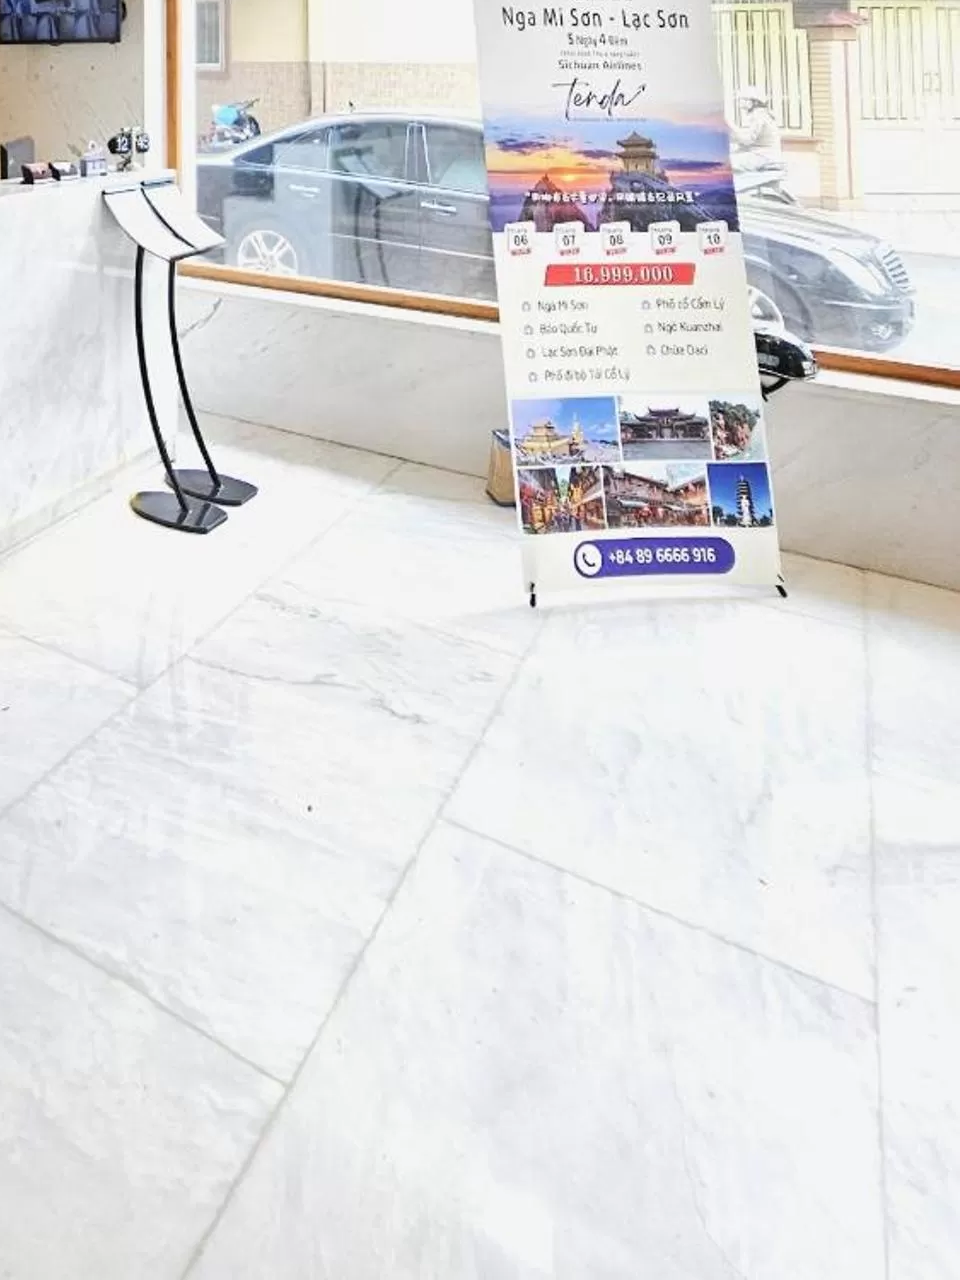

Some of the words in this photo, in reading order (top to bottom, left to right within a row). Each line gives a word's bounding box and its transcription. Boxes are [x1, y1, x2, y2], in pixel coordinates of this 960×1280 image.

[501, 7, 537, 31] Nga
[543, 8, 564, 28] Mi
[570, 8, 603, 28] Sơn
[621, 9, 651, 32] Lạc
[657, 9, 690, 29] Sơn
[567, 32, 574, 45] 5
[599, 32, 606, 46] 4
[557, 59, 600, 70] Sichuan
[602, 60, 643, 71] Airlines
[513, 235, 529, 246] 06
[562, 235, 576, 246] 07
[608, 234, 624, 246] 08
[658, 234, 673, 245] 09
[706, 233, 721, 245] 10
[608, 549, 633, 564] +84
[635, 548, 653, 563] 89
[655, 547, 690, 563] 6666
[692, 547, 716, 562] 916
